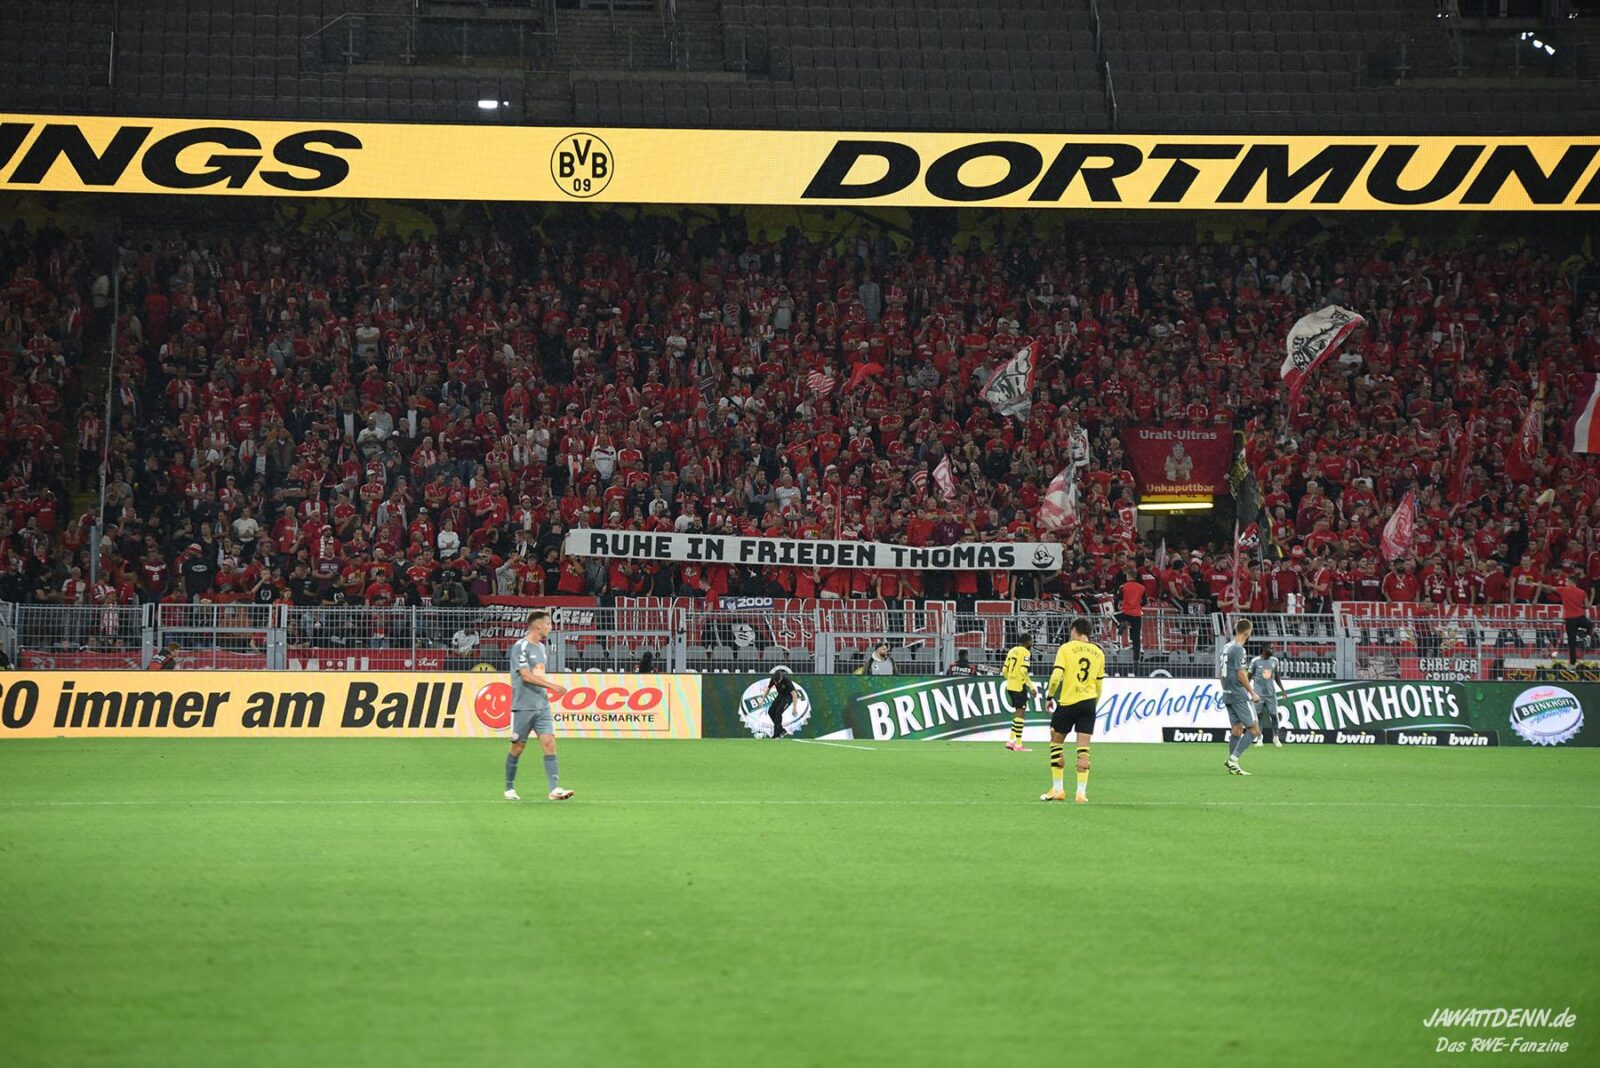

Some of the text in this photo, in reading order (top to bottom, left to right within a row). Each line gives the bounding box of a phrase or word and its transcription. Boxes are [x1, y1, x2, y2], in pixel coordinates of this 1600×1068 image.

[559, 138, 608, 179] BVB
[573, 178, 592, 192] 09
[1139, 430, 1217, 440] Uralt-Ultras
[590, 533, 1016, 568] RUHE IN FRIEDEN THOMAS
[737, 598, 772, 608] 2000
[1077, 657, 1091, 682] 3
[53, 681, 231, 728] immer
[241, 691, 326, 728] am
[340, 681, 463, 728] Ball!
[1174, 729, 1213, 742] bwin
[1286, 731, 1325, 743] bwin
[1336, 731, 1376, 744] bwin
[1398, 732, 1438, 745] bwin
[1449, 733, 1489, 746] bwin
